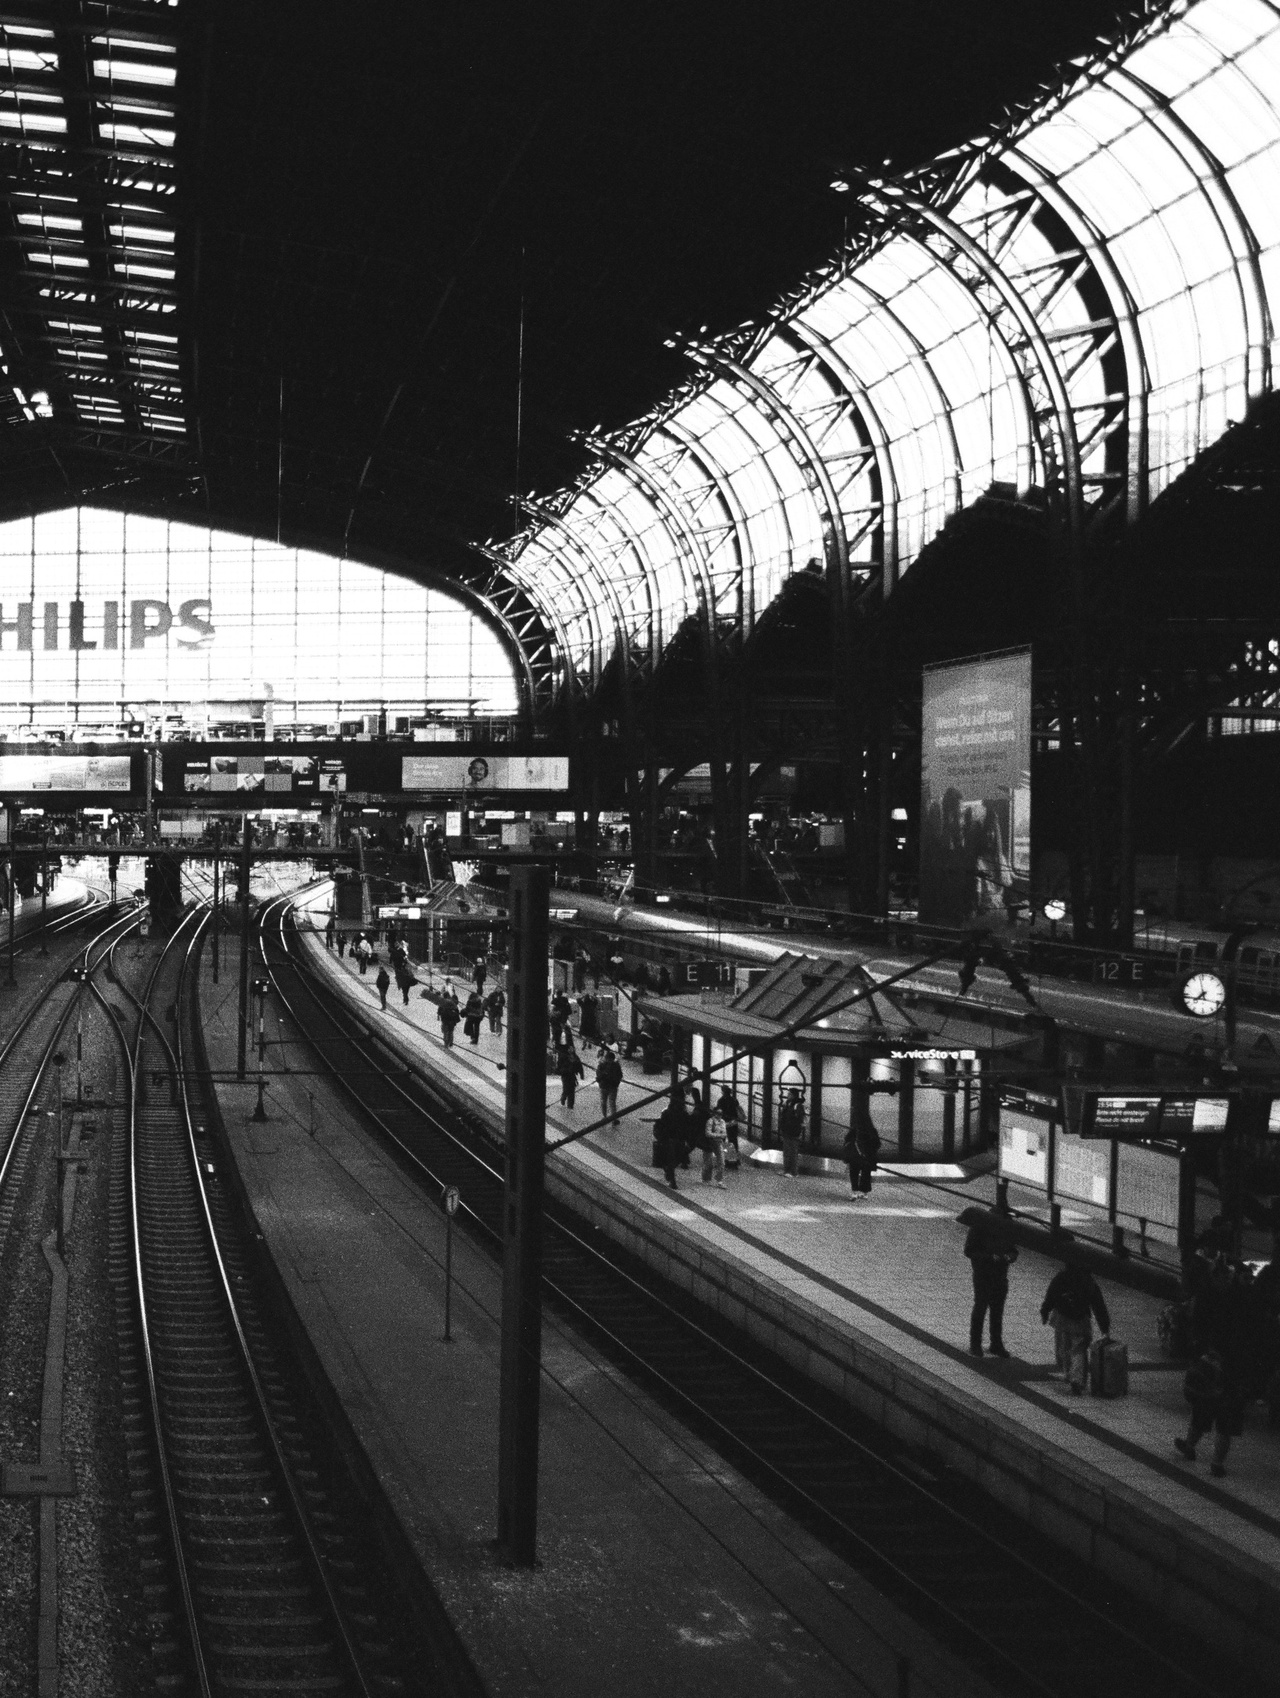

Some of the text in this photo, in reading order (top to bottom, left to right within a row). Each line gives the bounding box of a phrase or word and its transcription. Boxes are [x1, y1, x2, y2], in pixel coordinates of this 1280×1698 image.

[686, 964, 731, 982] E 11
[1098, 962, 1143, 980] 12 E
